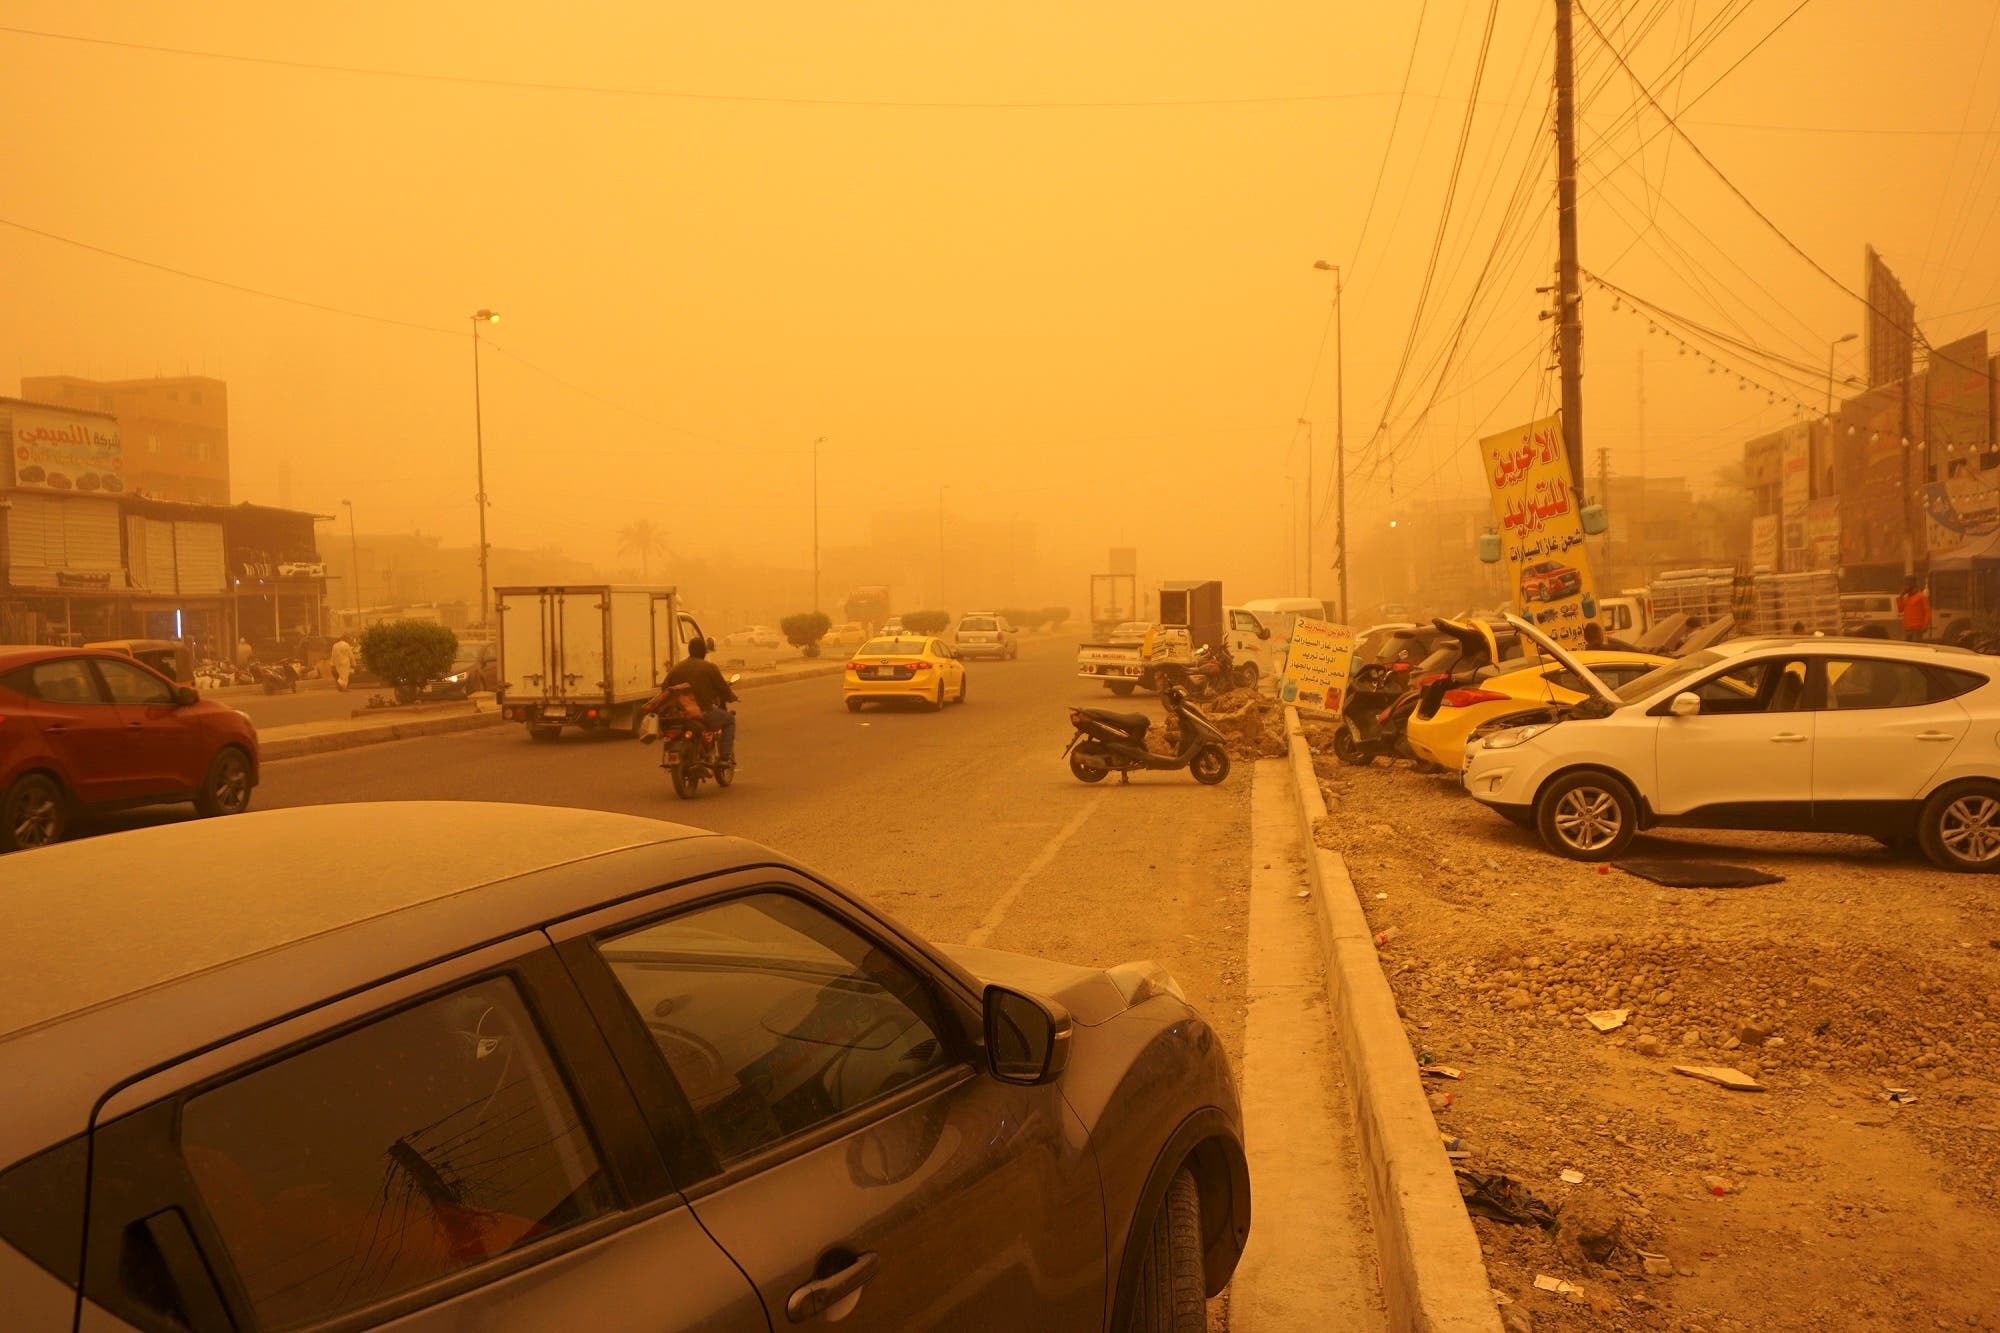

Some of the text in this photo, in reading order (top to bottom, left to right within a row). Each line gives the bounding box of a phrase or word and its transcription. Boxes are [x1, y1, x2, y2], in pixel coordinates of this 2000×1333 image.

[1492, 425, 1560, 489] الاخوين
[1503, 477, 1570, 538] للتبريد
[1510, 530, 1584, 562] شحن غاز السيارات
[1298, 619, 1305, 629] 2
[1294, 635, 1320, 646] السيارات
